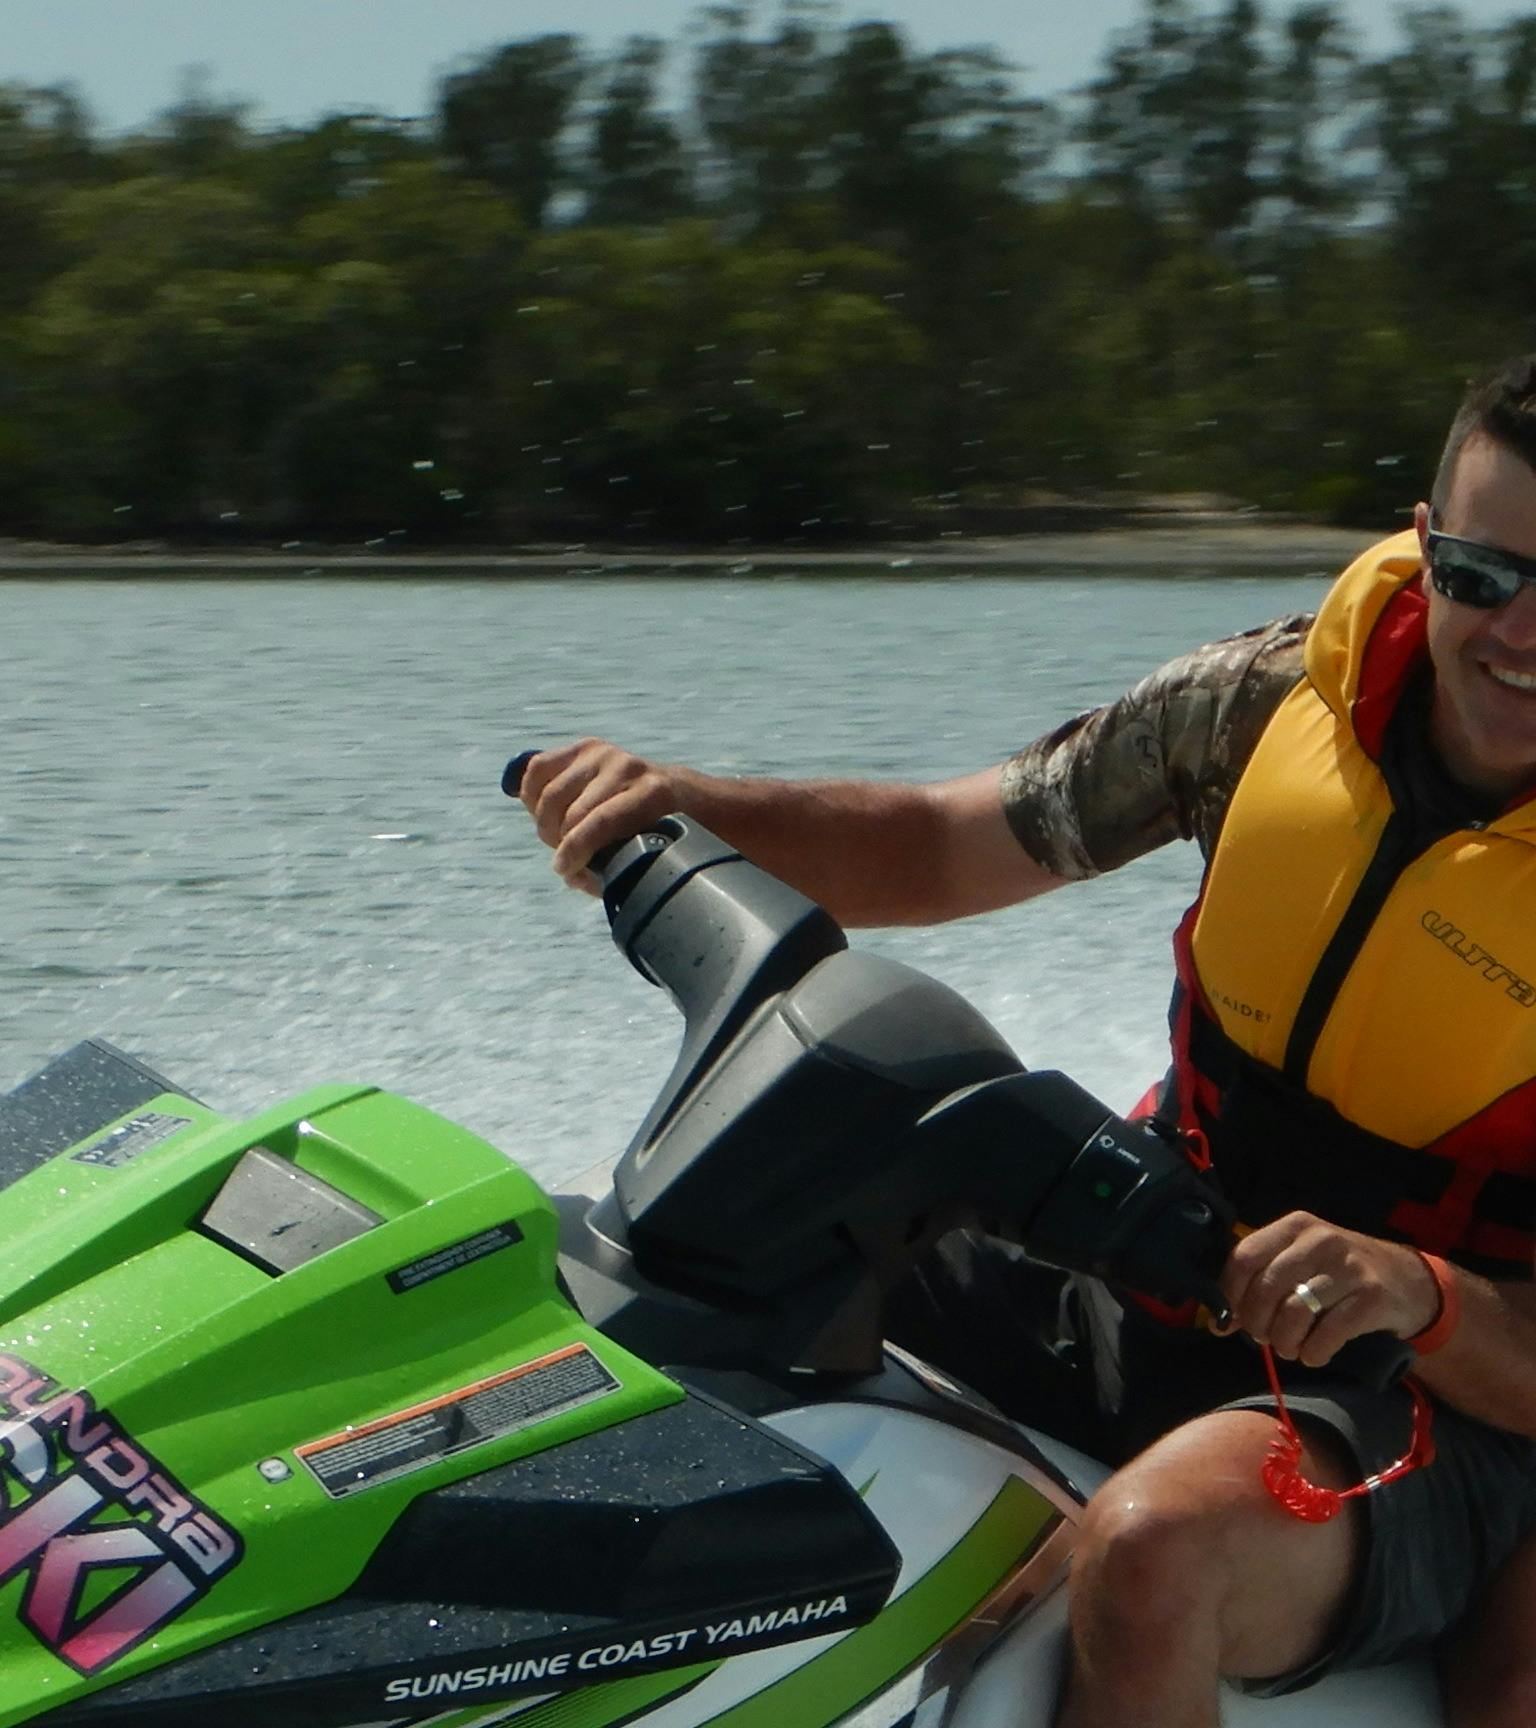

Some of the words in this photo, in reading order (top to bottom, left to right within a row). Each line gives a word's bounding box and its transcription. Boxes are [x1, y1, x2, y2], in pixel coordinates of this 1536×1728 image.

[383, 1653, 570, 1702] SUNSHINE
[577, 1628, 697, 1670] COAST
[705, 1595, 849, 1645] YAMAHA
